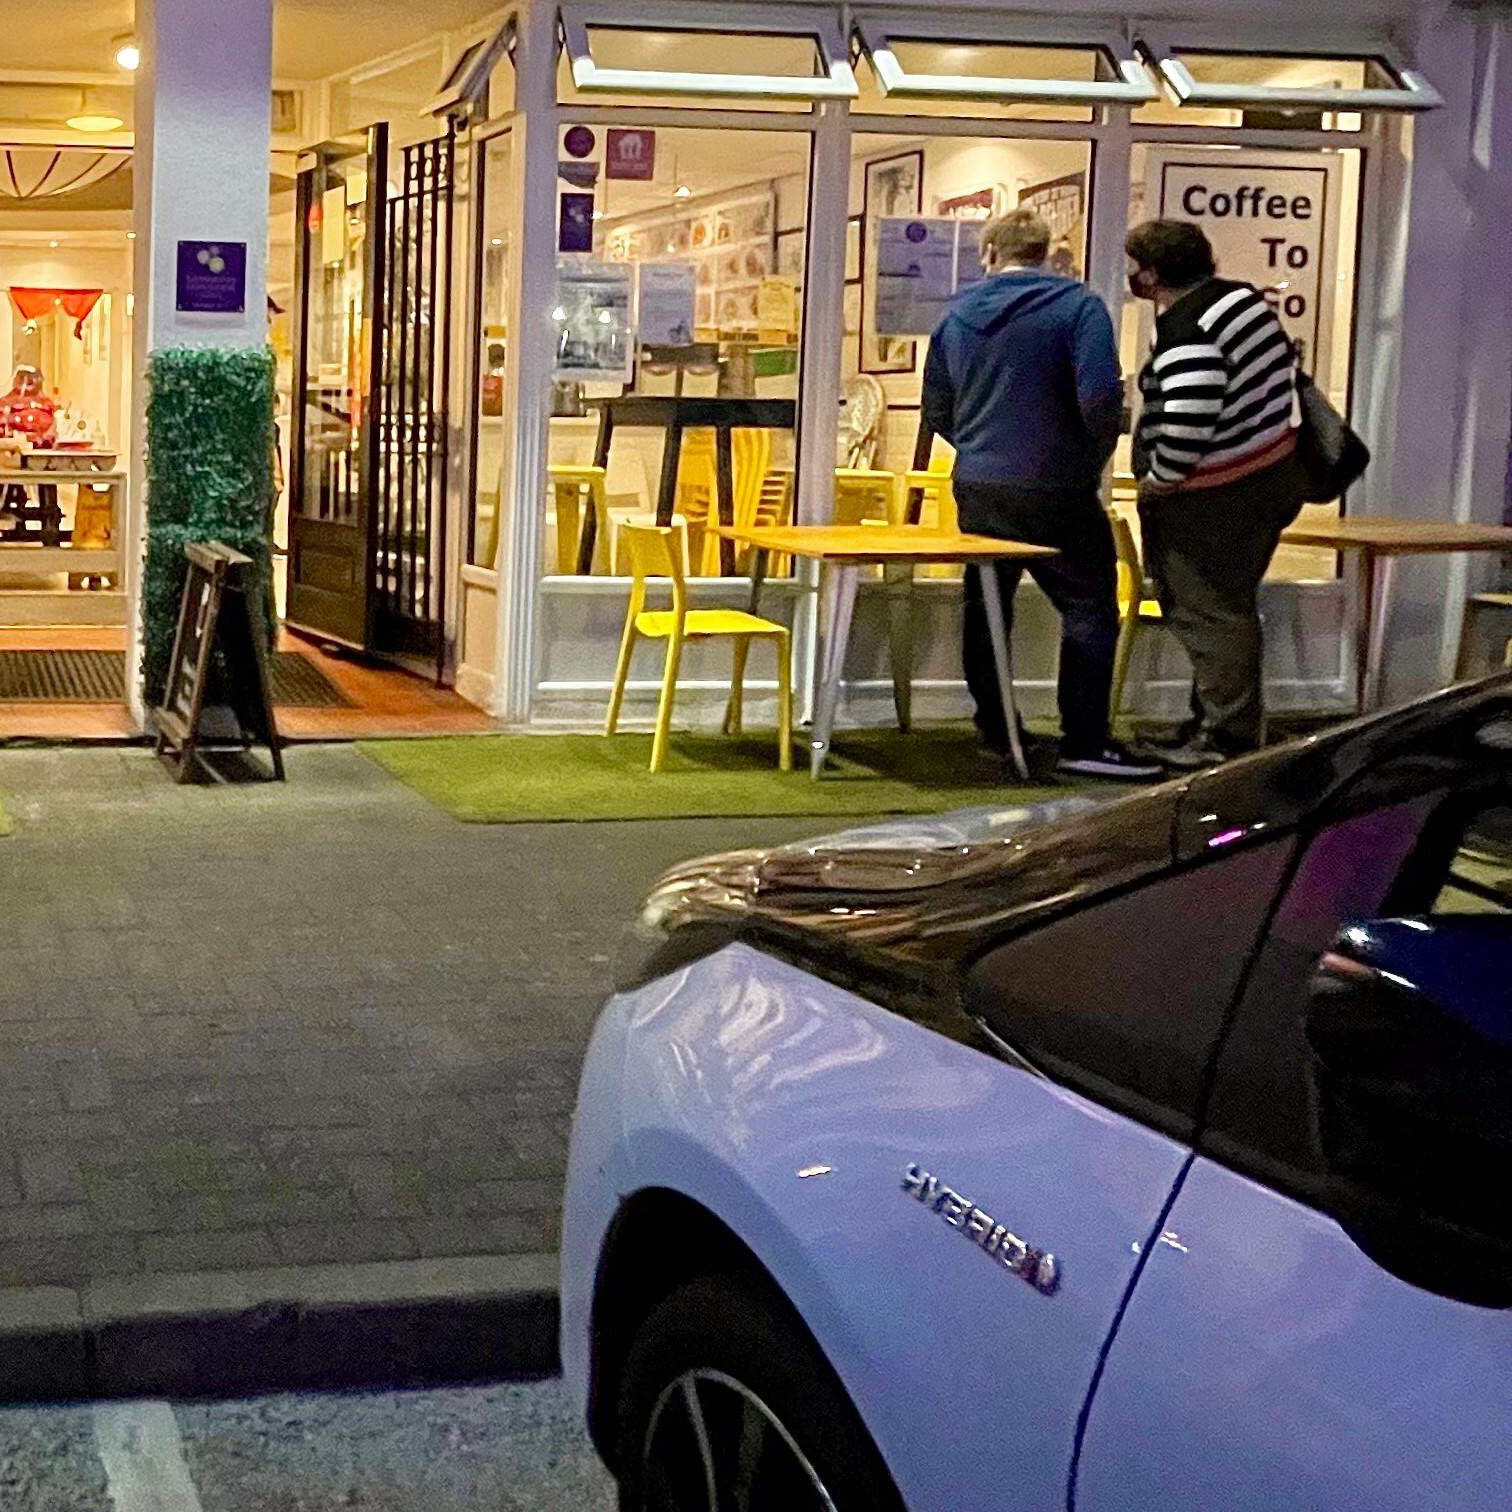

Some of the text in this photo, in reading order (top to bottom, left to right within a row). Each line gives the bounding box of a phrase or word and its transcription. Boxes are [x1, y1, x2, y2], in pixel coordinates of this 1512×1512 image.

[1182, 185, 1313, 220] Coffee
[1260, 238, 1309, 270] To
[900, 1161, 1031, 1278] HYBRID
